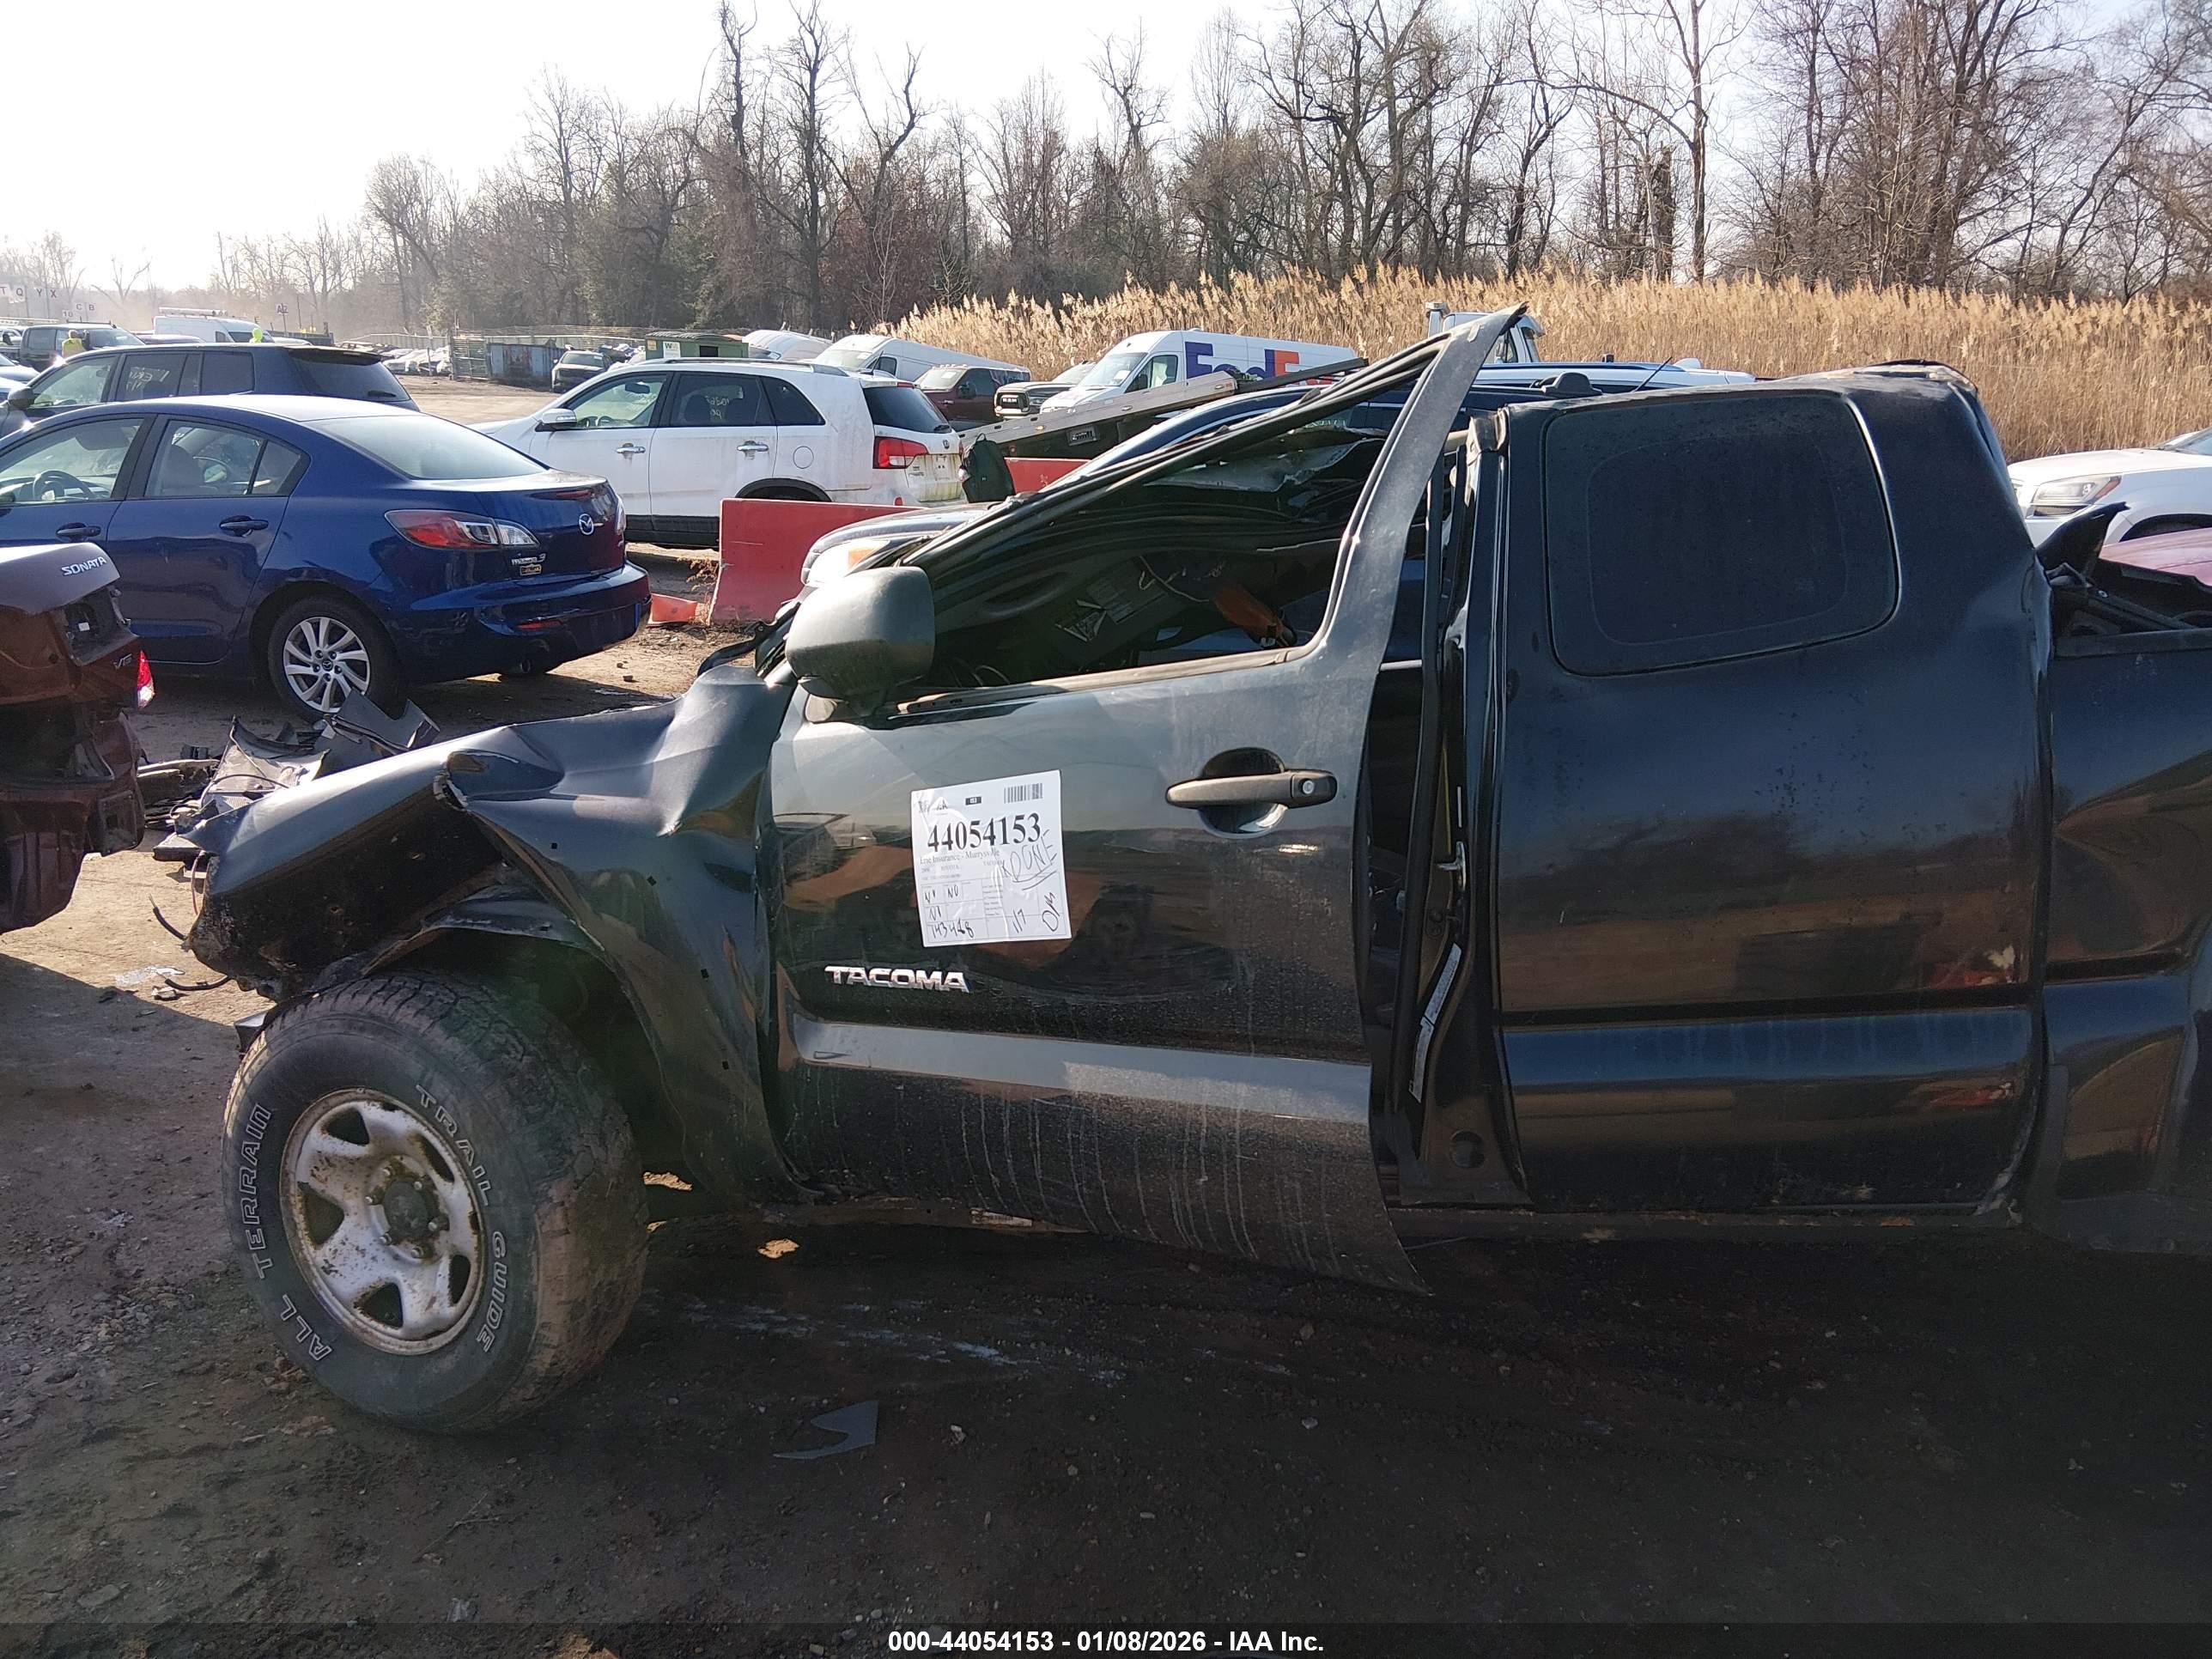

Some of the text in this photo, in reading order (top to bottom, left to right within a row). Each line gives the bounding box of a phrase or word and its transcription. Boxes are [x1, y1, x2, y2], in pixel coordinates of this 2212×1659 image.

[15, 288, 24, 296] Q
[61, 556, 107, 576] SONATA
[927, 812, 1042, 853] 44054153
[824, 965, 970, 994] TACOMA
[238, 1103, 333, 1362] ALL TERRAIN
[415, 1085, 508, 1353] TRAIL GUIDE
